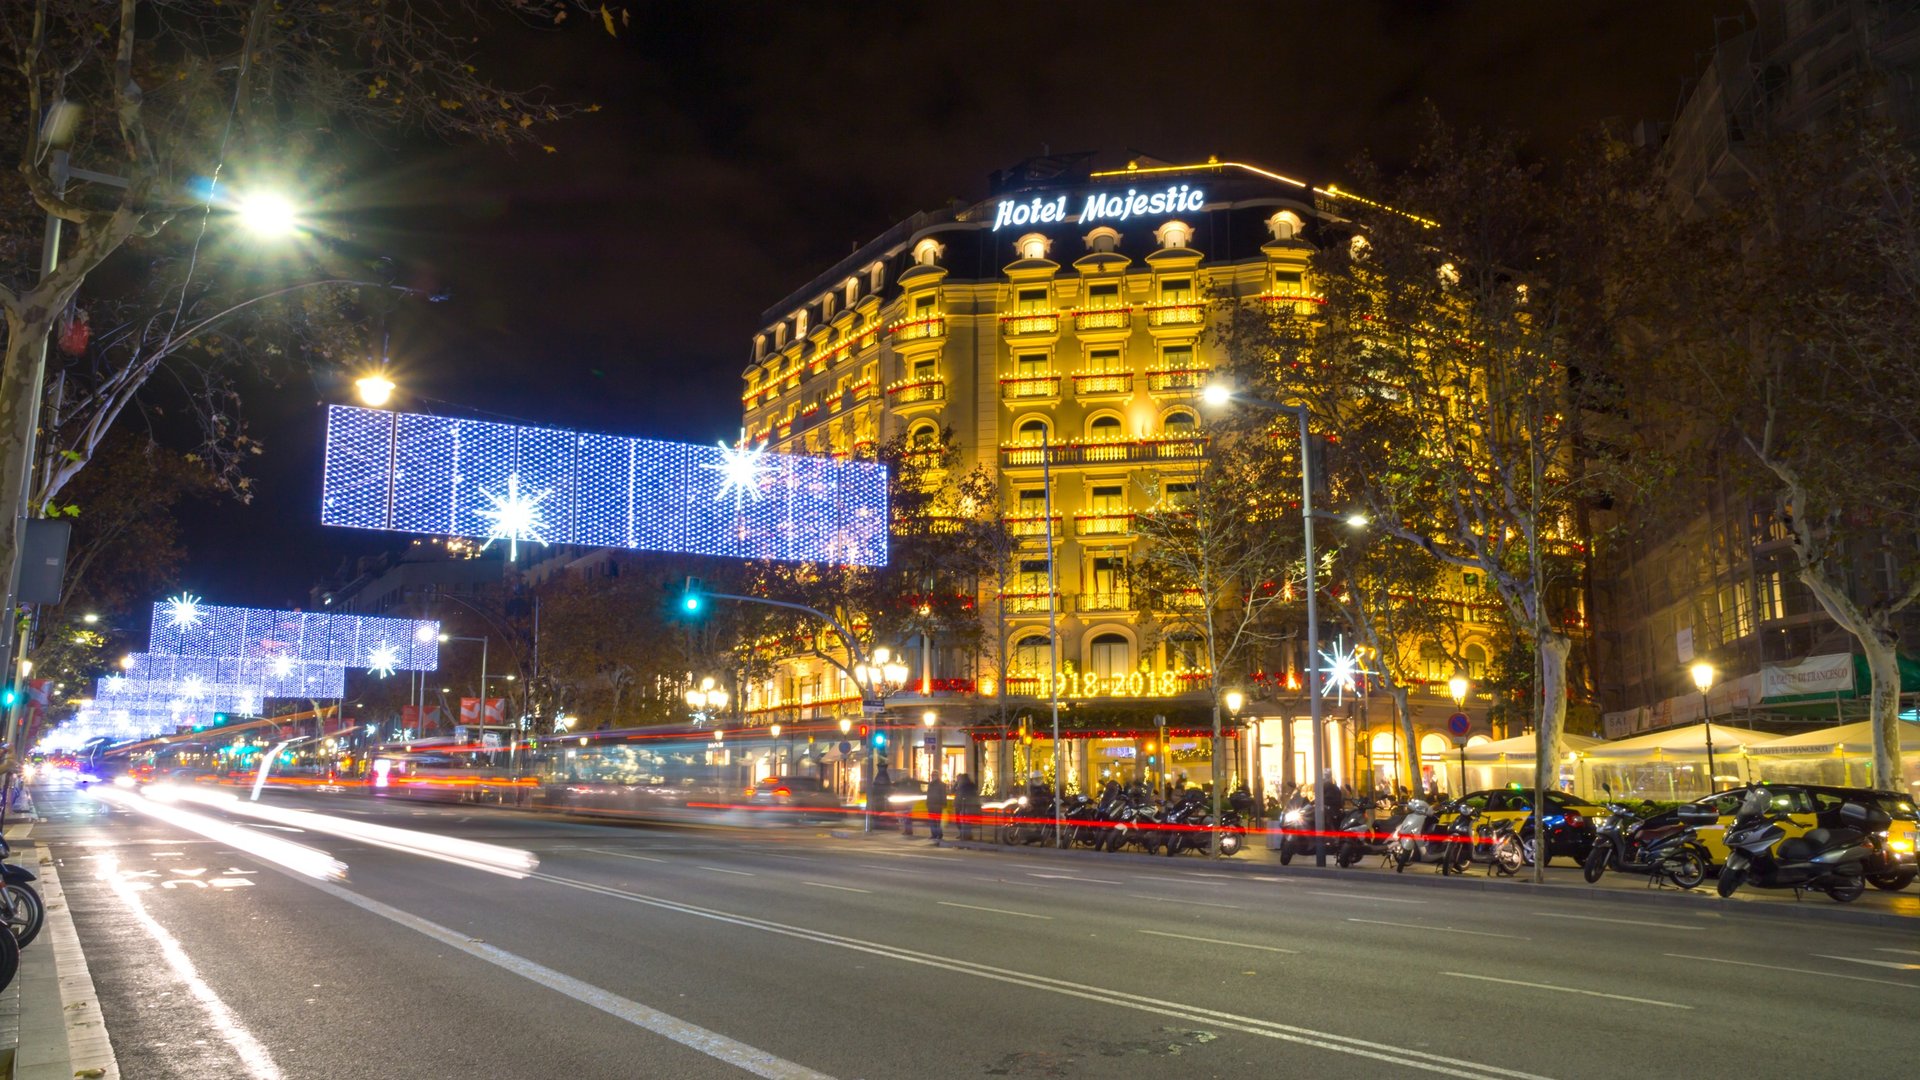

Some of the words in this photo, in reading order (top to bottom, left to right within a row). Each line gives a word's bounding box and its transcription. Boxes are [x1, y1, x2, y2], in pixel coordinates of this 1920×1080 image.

[992, 195, 1067, 232] Hotel
[1078, 184, 1204, 225] Majestic
[1807, 667, 1848, 682] FRANCESCO
